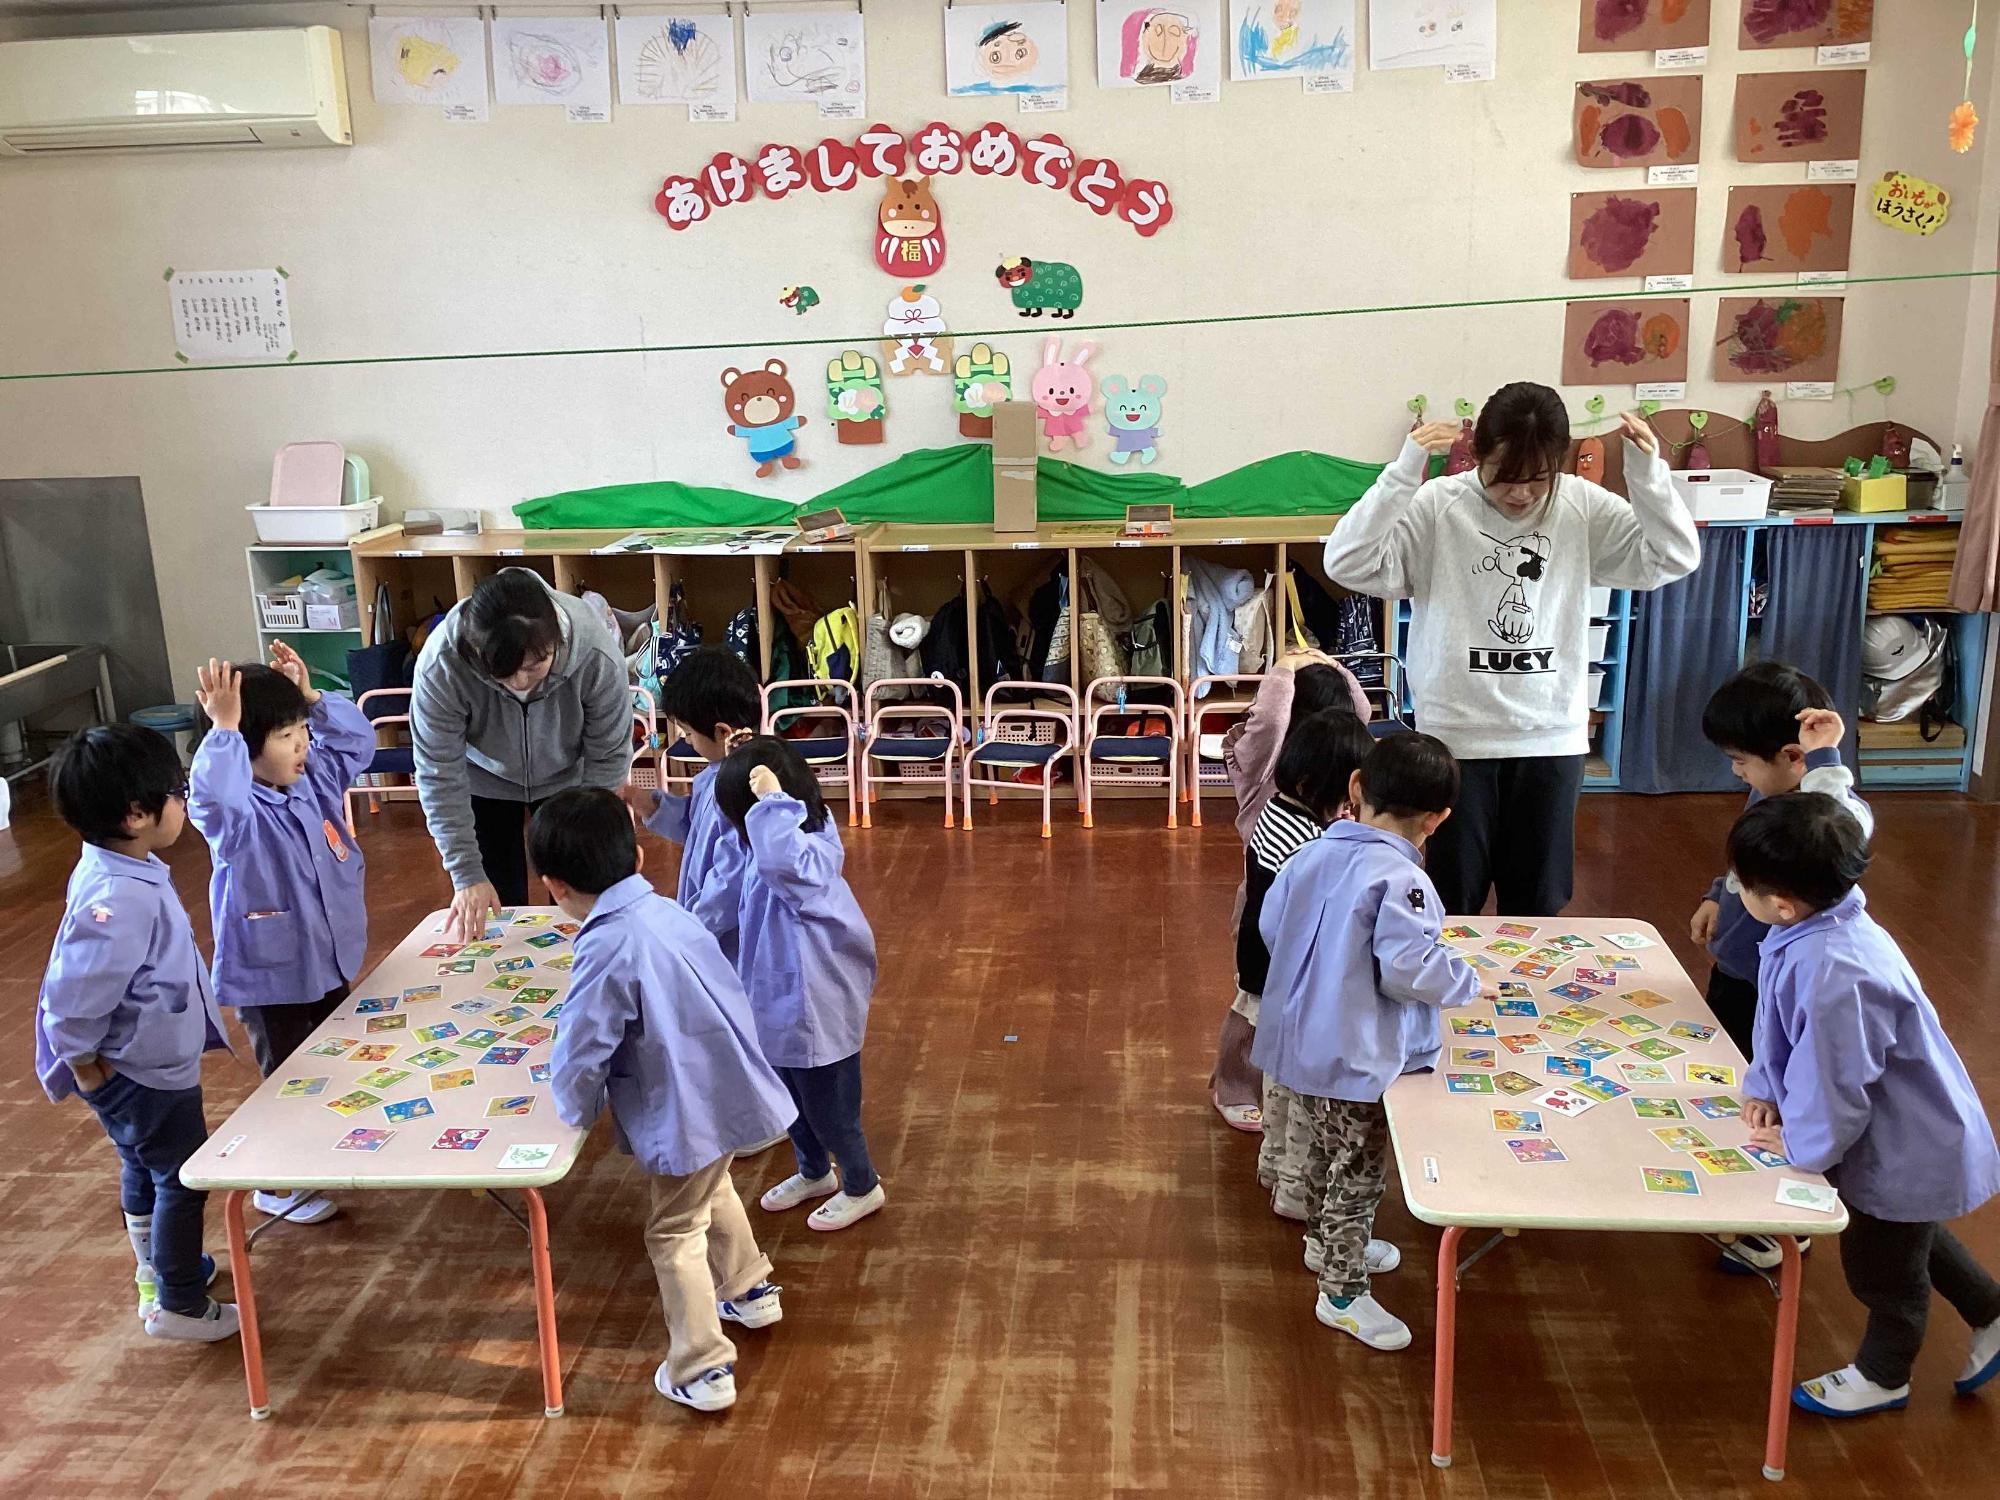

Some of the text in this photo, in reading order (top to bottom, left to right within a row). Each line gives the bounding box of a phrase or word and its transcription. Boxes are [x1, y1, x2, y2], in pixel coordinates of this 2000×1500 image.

[664, 128, 1167, 226] あけましておめでとう
[1888, 180, 1936, 209] おいもが
[901, 240, 921, 262] 福
[1469, 650, 1553, 671] LUCY
